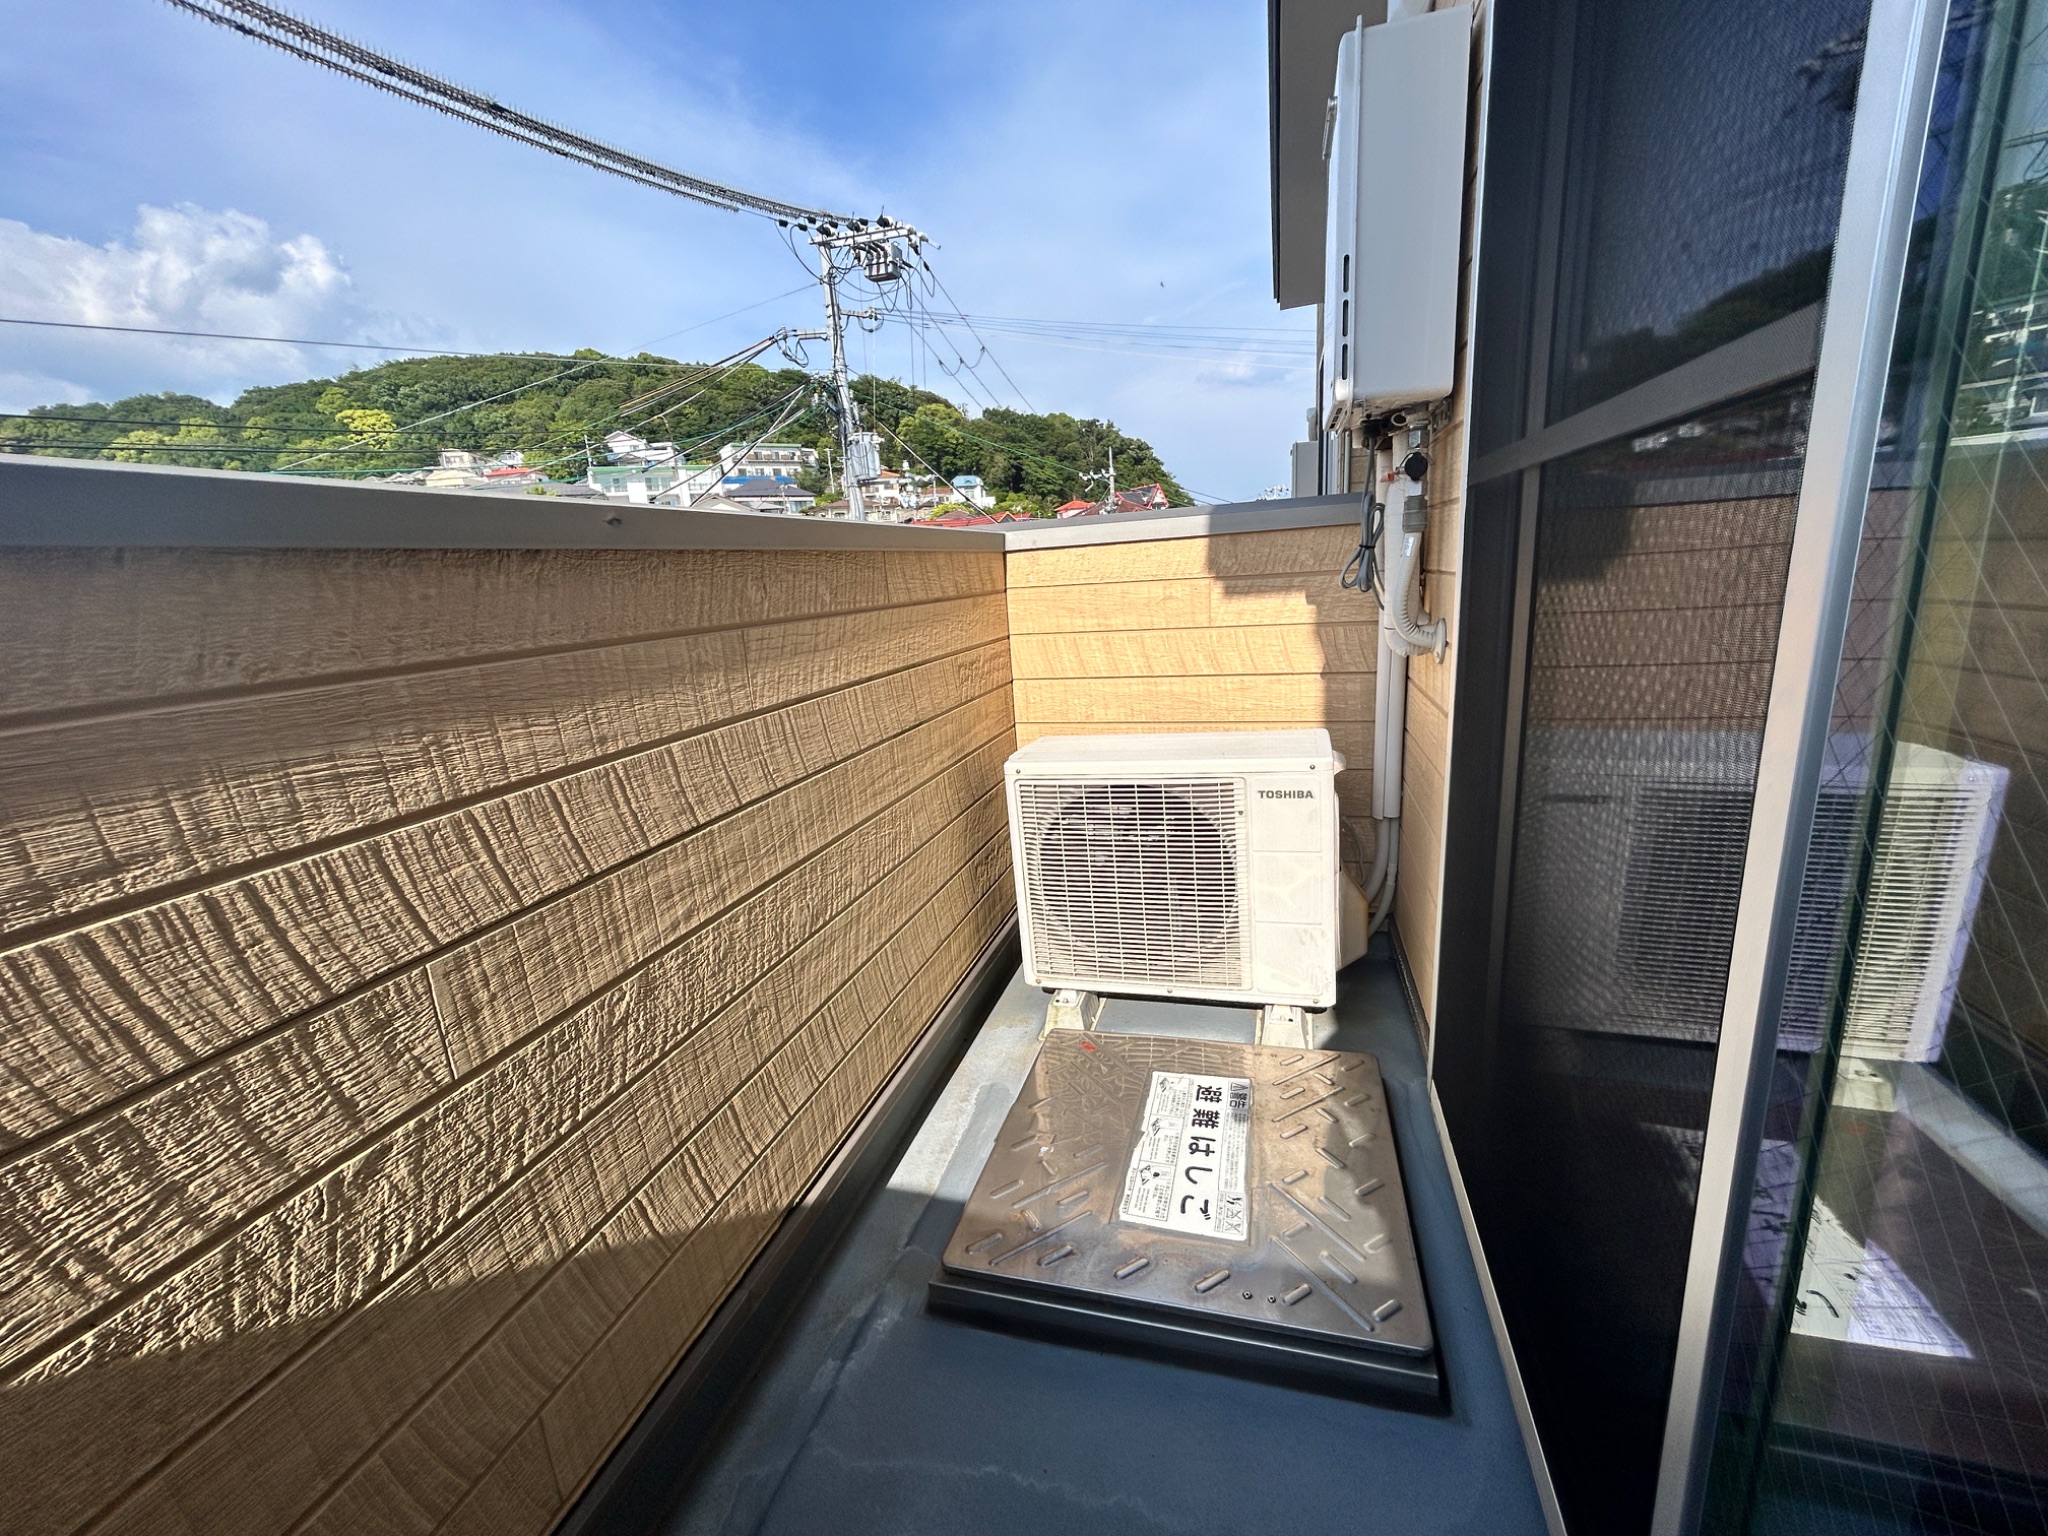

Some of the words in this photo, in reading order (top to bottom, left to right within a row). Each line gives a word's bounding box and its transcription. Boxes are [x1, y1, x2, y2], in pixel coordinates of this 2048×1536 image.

[1257, 790, 1314, 799] TOSHIBA
[1229, 1092, 1248, 1109] 警告
[1180, 1084, 1223, 1221] 避難はしご
